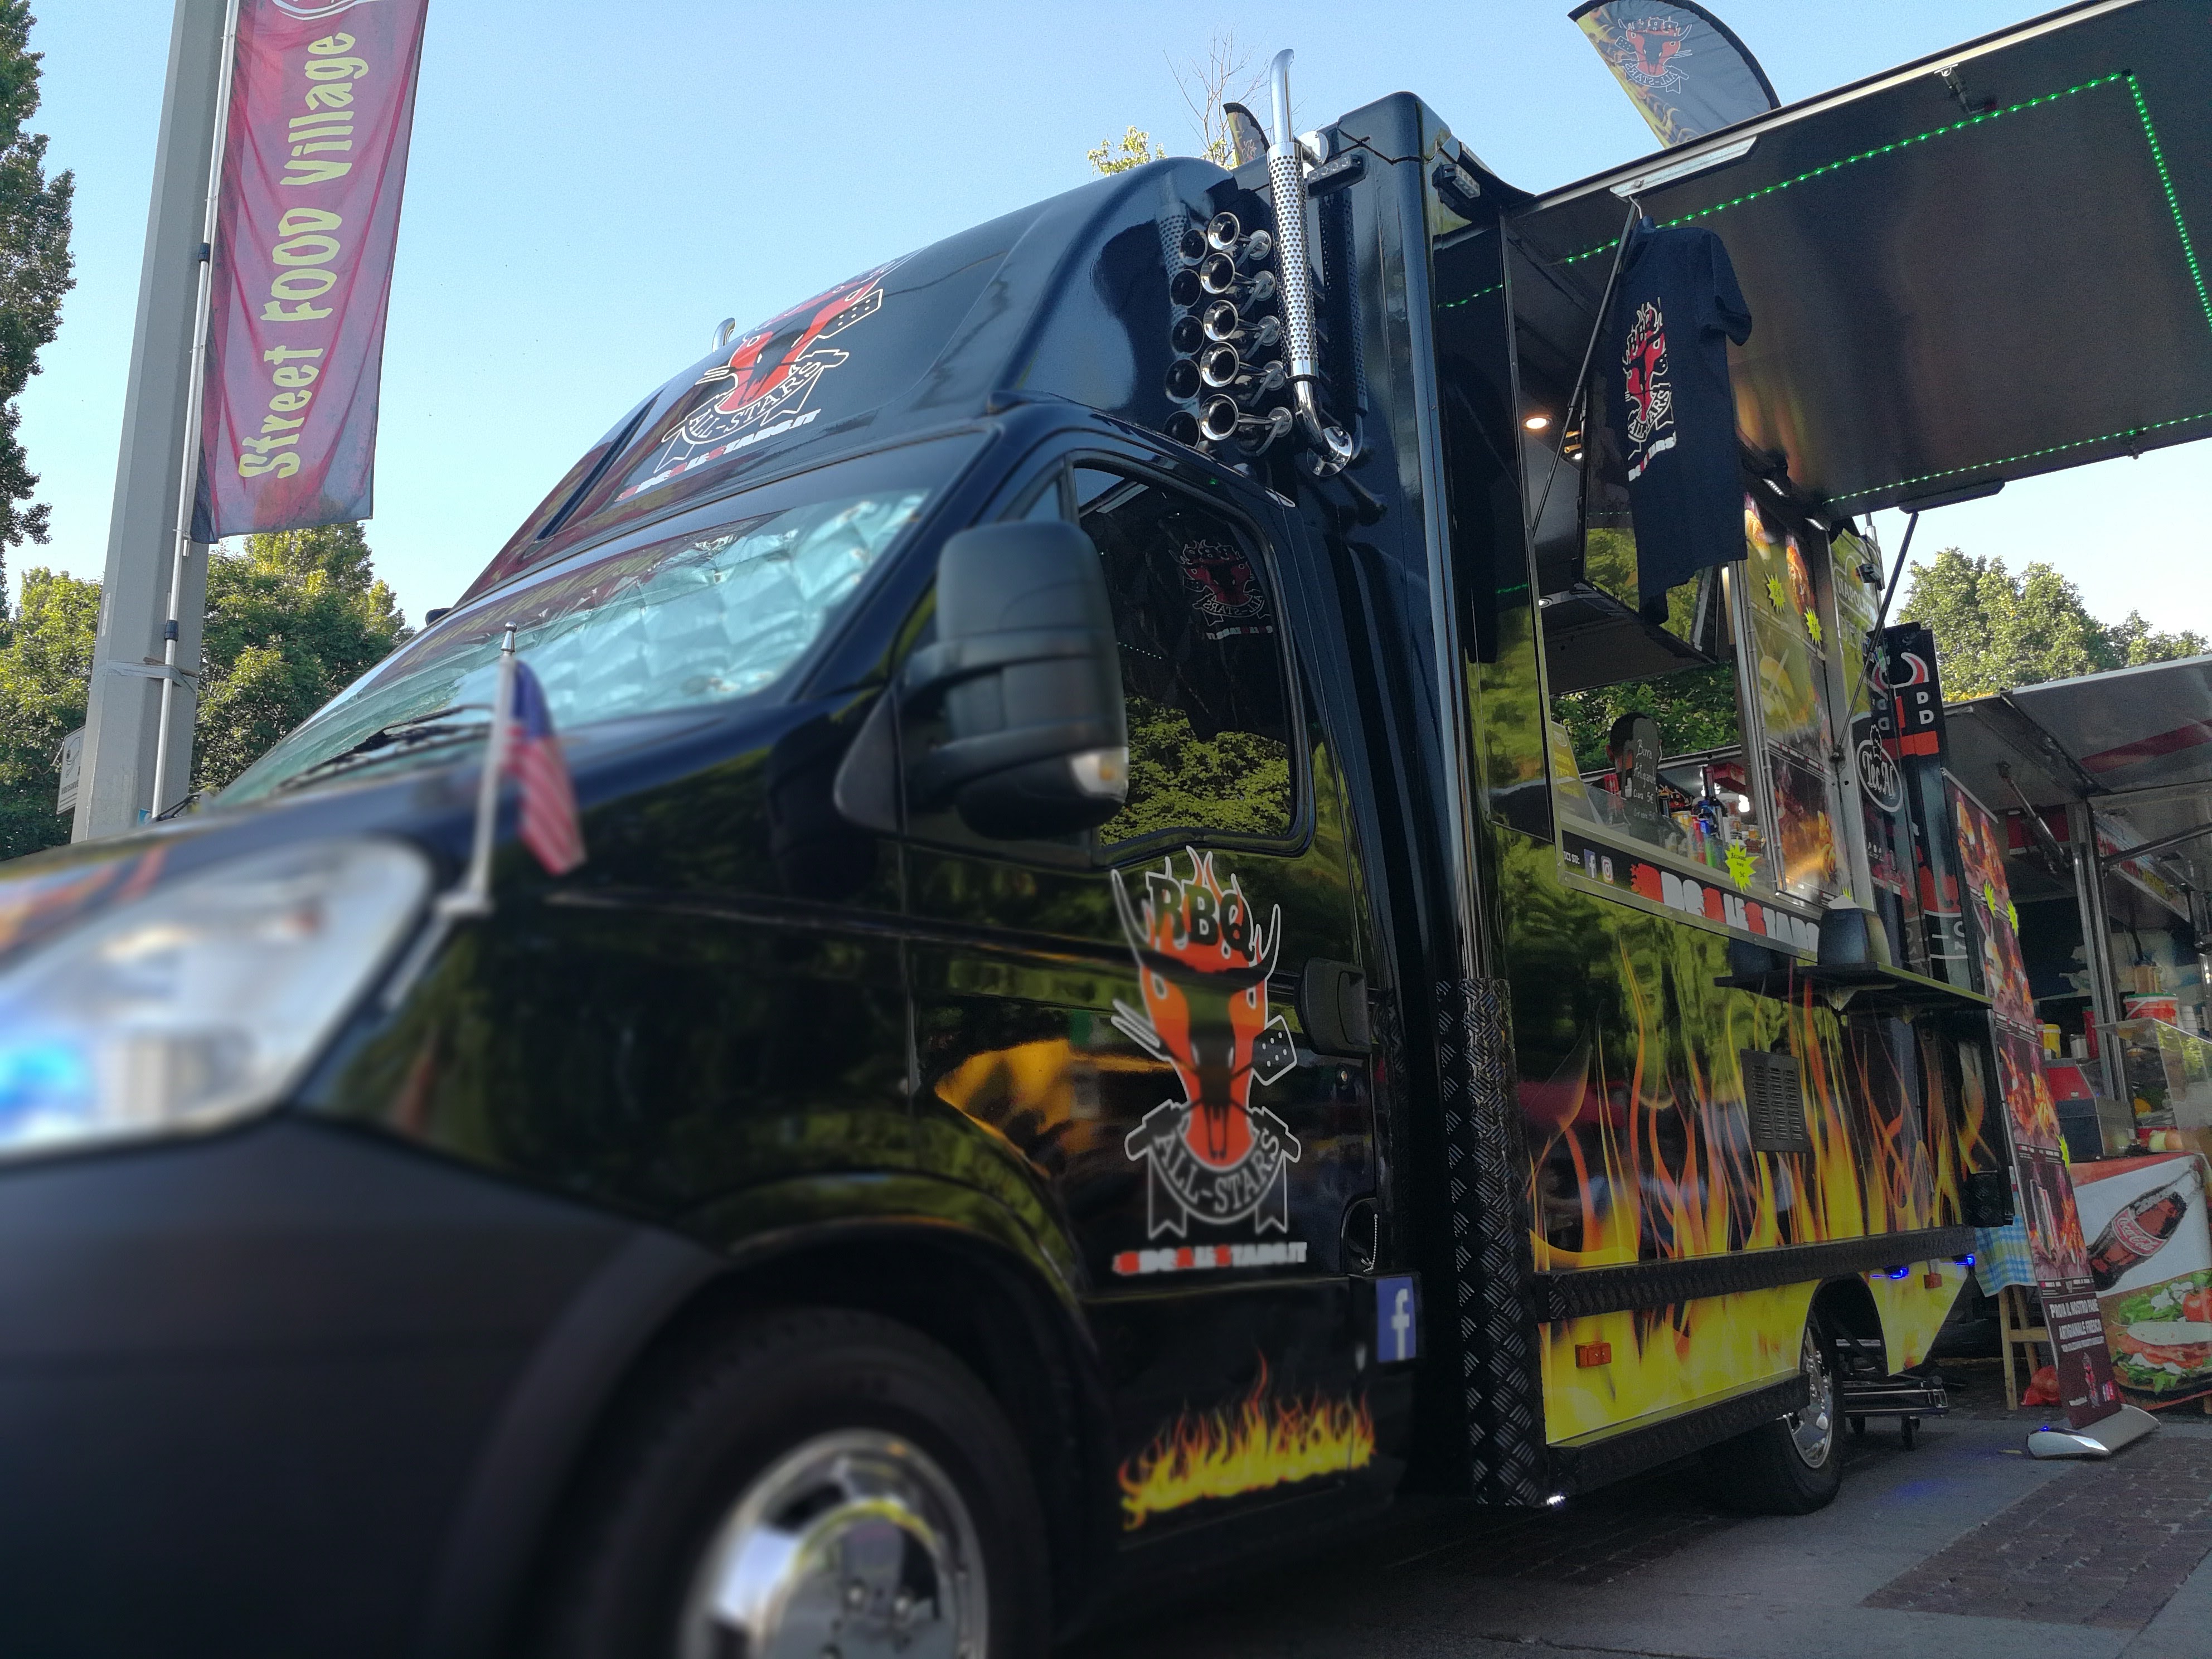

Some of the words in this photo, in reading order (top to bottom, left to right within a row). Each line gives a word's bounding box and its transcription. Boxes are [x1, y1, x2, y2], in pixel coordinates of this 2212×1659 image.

[279, 32, 368, 186] Village
[260, 207, 342, 322] FOOD
[239, 345, 323, 478] Street
[689, 360, 821, 439] ALL-STARS
[1152, 1127, 1280, 1214] ALL-STARS
